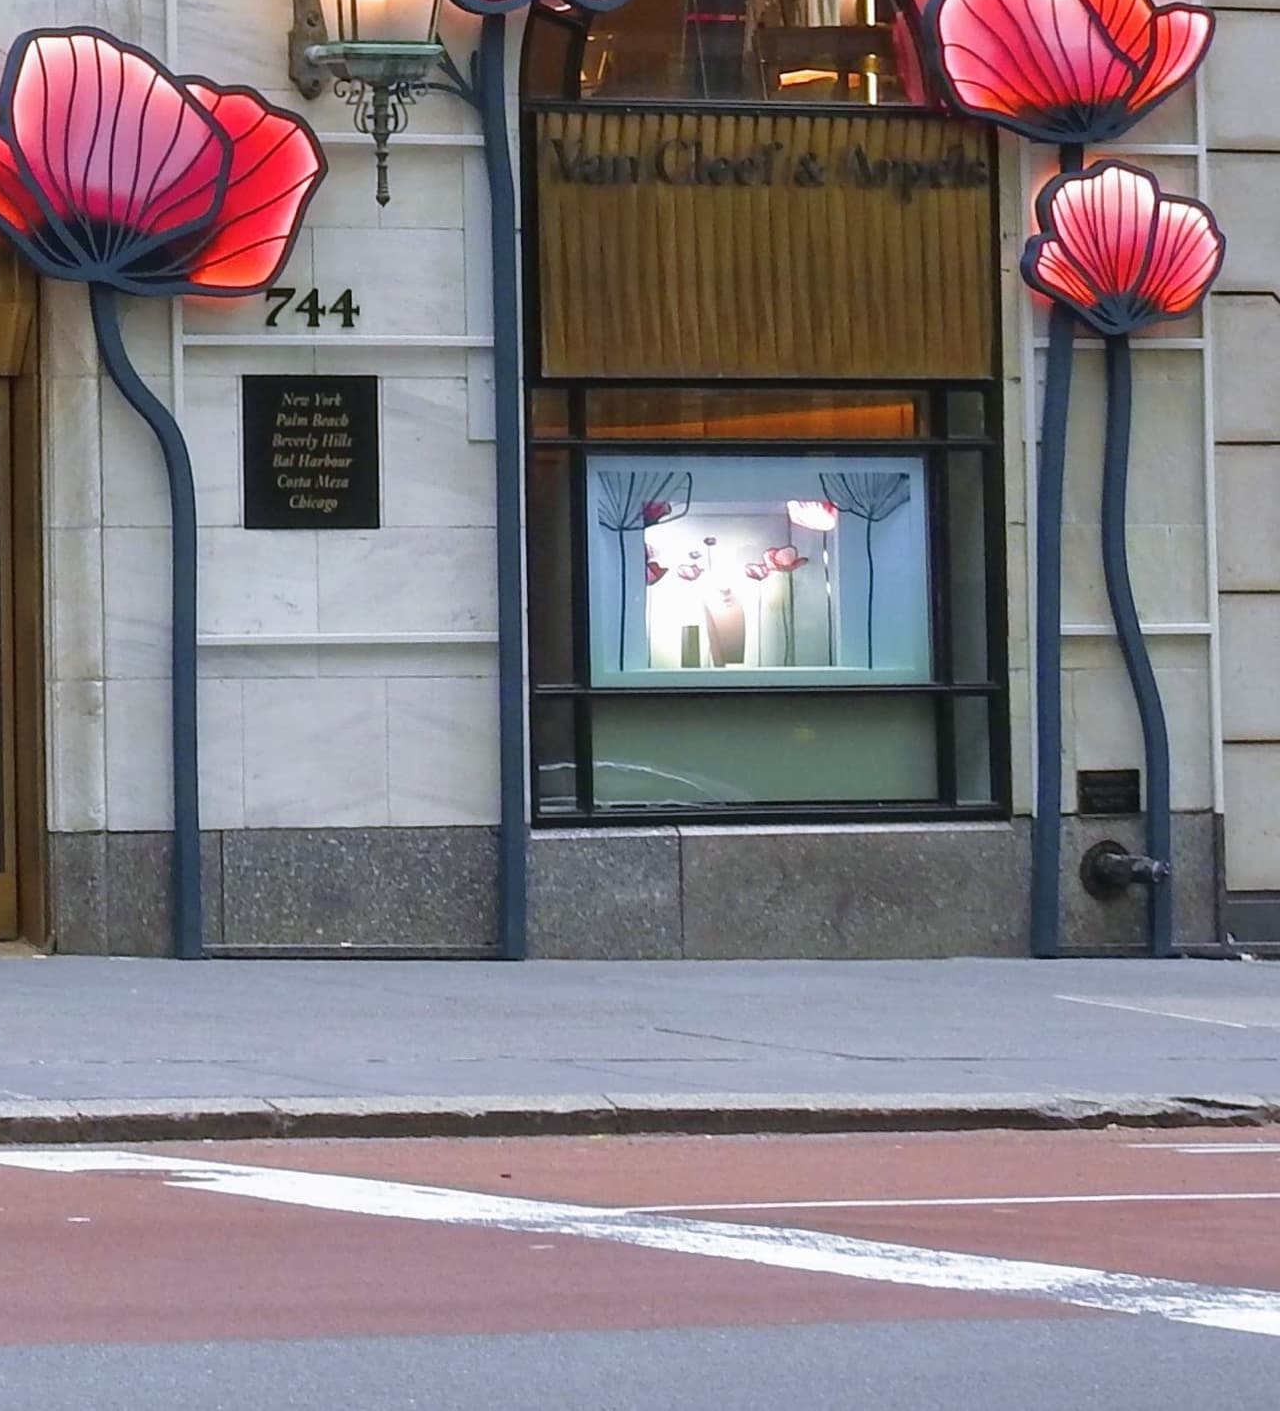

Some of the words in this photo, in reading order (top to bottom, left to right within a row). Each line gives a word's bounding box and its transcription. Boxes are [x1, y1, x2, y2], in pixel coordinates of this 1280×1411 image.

[265, 288, 360, 328] 744
[276, 412, 308, 427] Palm
[289, 494, 339, 513] Chicago
